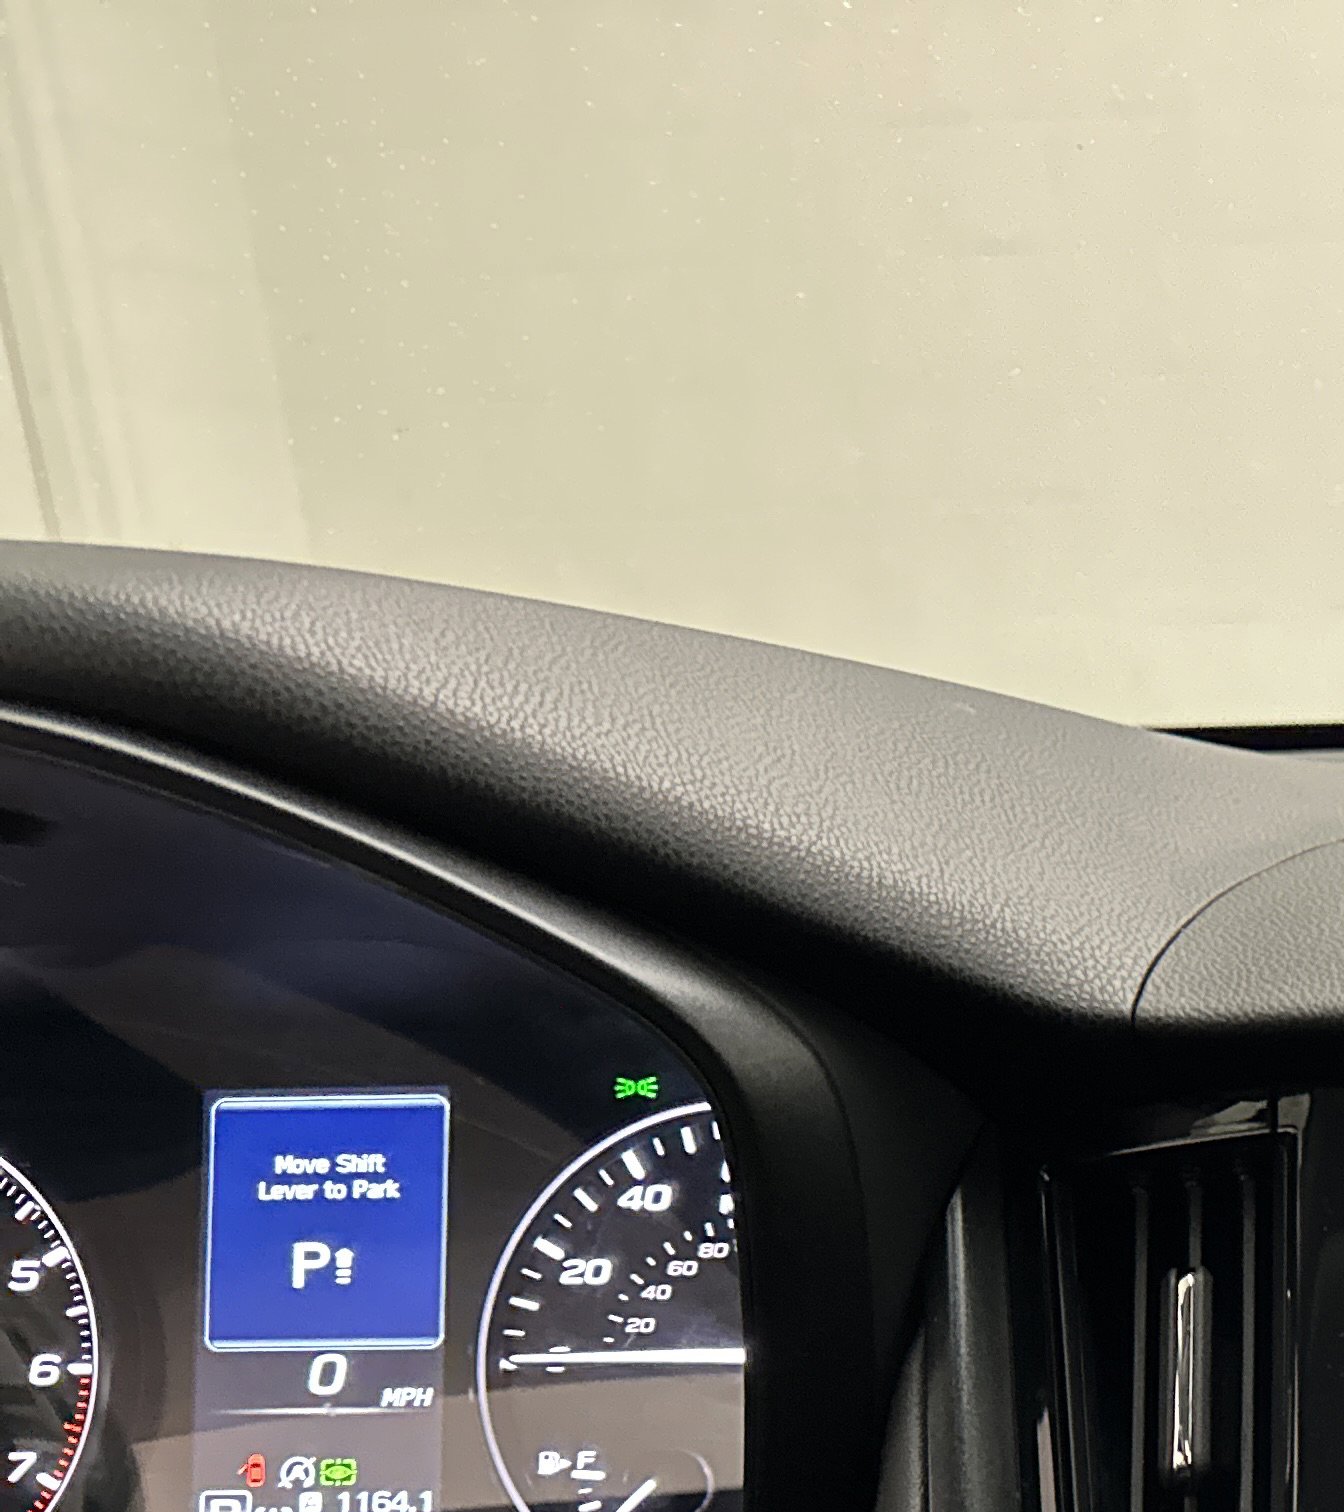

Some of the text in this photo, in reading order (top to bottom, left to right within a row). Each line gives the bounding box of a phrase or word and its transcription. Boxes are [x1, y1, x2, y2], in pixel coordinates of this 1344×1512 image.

[274, 1153, 387, 1175] Move Shift
[257, 1179, 401, 1201] Lever to Park
[617, 1183, 673, 1212] 40
[697, 1242, 730, 1259] 80
[7, 1259, 42, 1292] 5
[558, 1258, 613, 1286] 20
[666, 1260, 699, 1276] 60
[640, 1284, 673, 1300] 40
[624, 1317, 656, 1333] 20
[28, 1353, 62, 1386] 6
[308, 1354, 348, 1396] 0
[380, 1387, 435, 1408] MPH
[7, 1451, 38, 1484] 7
[577, 1450, 597, 1470] F
